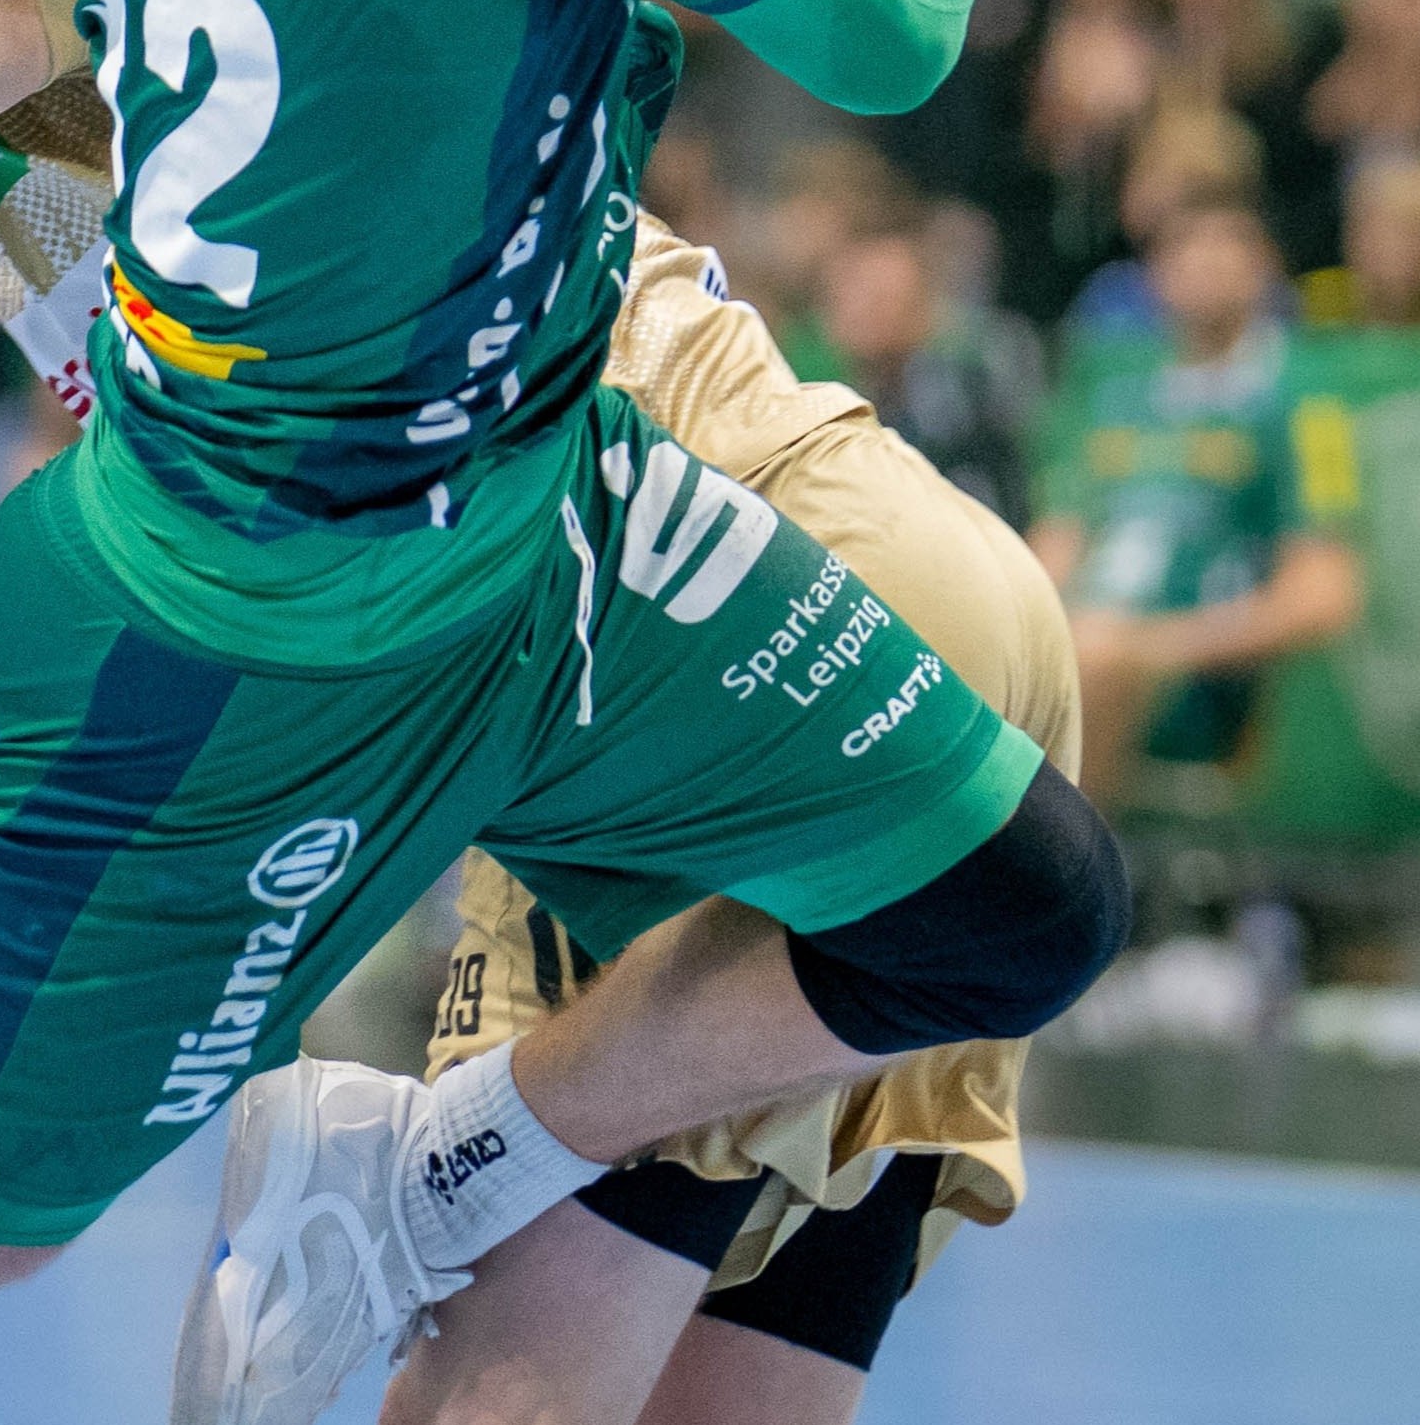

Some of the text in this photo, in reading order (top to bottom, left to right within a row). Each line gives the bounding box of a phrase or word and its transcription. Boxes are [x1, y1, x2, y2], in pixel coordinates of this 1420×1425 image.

[782, 594, 891, 707] Leipzig
[841, 665, 931, 758] CRAFT
[143, 908, 308, 1127] Allianz
[443, 1128, 507, 1189] CRAFT
